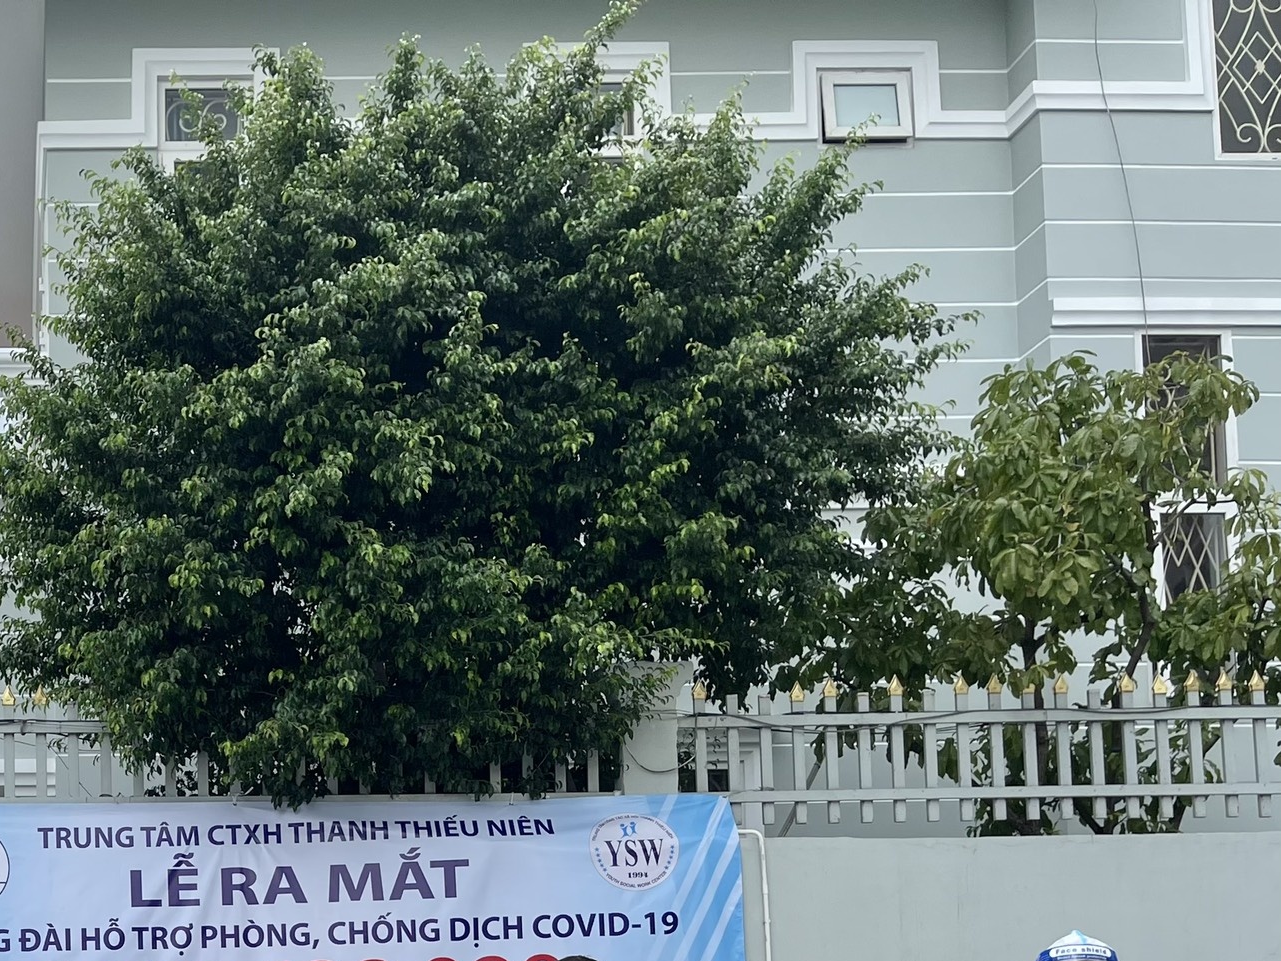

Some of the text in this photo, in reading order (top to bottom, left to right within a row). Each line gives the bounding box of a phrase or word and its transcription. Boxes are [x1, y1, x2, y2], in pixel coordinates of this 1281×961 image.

[38, 815, 554, 849] TRUNG TÂM CTXH THANH THIẾU NIÊN
[604, 839, 663, 867] YSW
[130, 847, 469, 907] LỄ RA MẮT
[19, 928, 71, 951] ĐÀI
[81, 918, 125, 950] HỖ
[132, 923, 193, 956] TRỢ
[202, 920, 319, 949] PHÒNG,
[328, 912, 440, 944] CHỐNG
[450, 916, 523, 948] DỊCH
[532, 911, 679, 938] COVID-19
